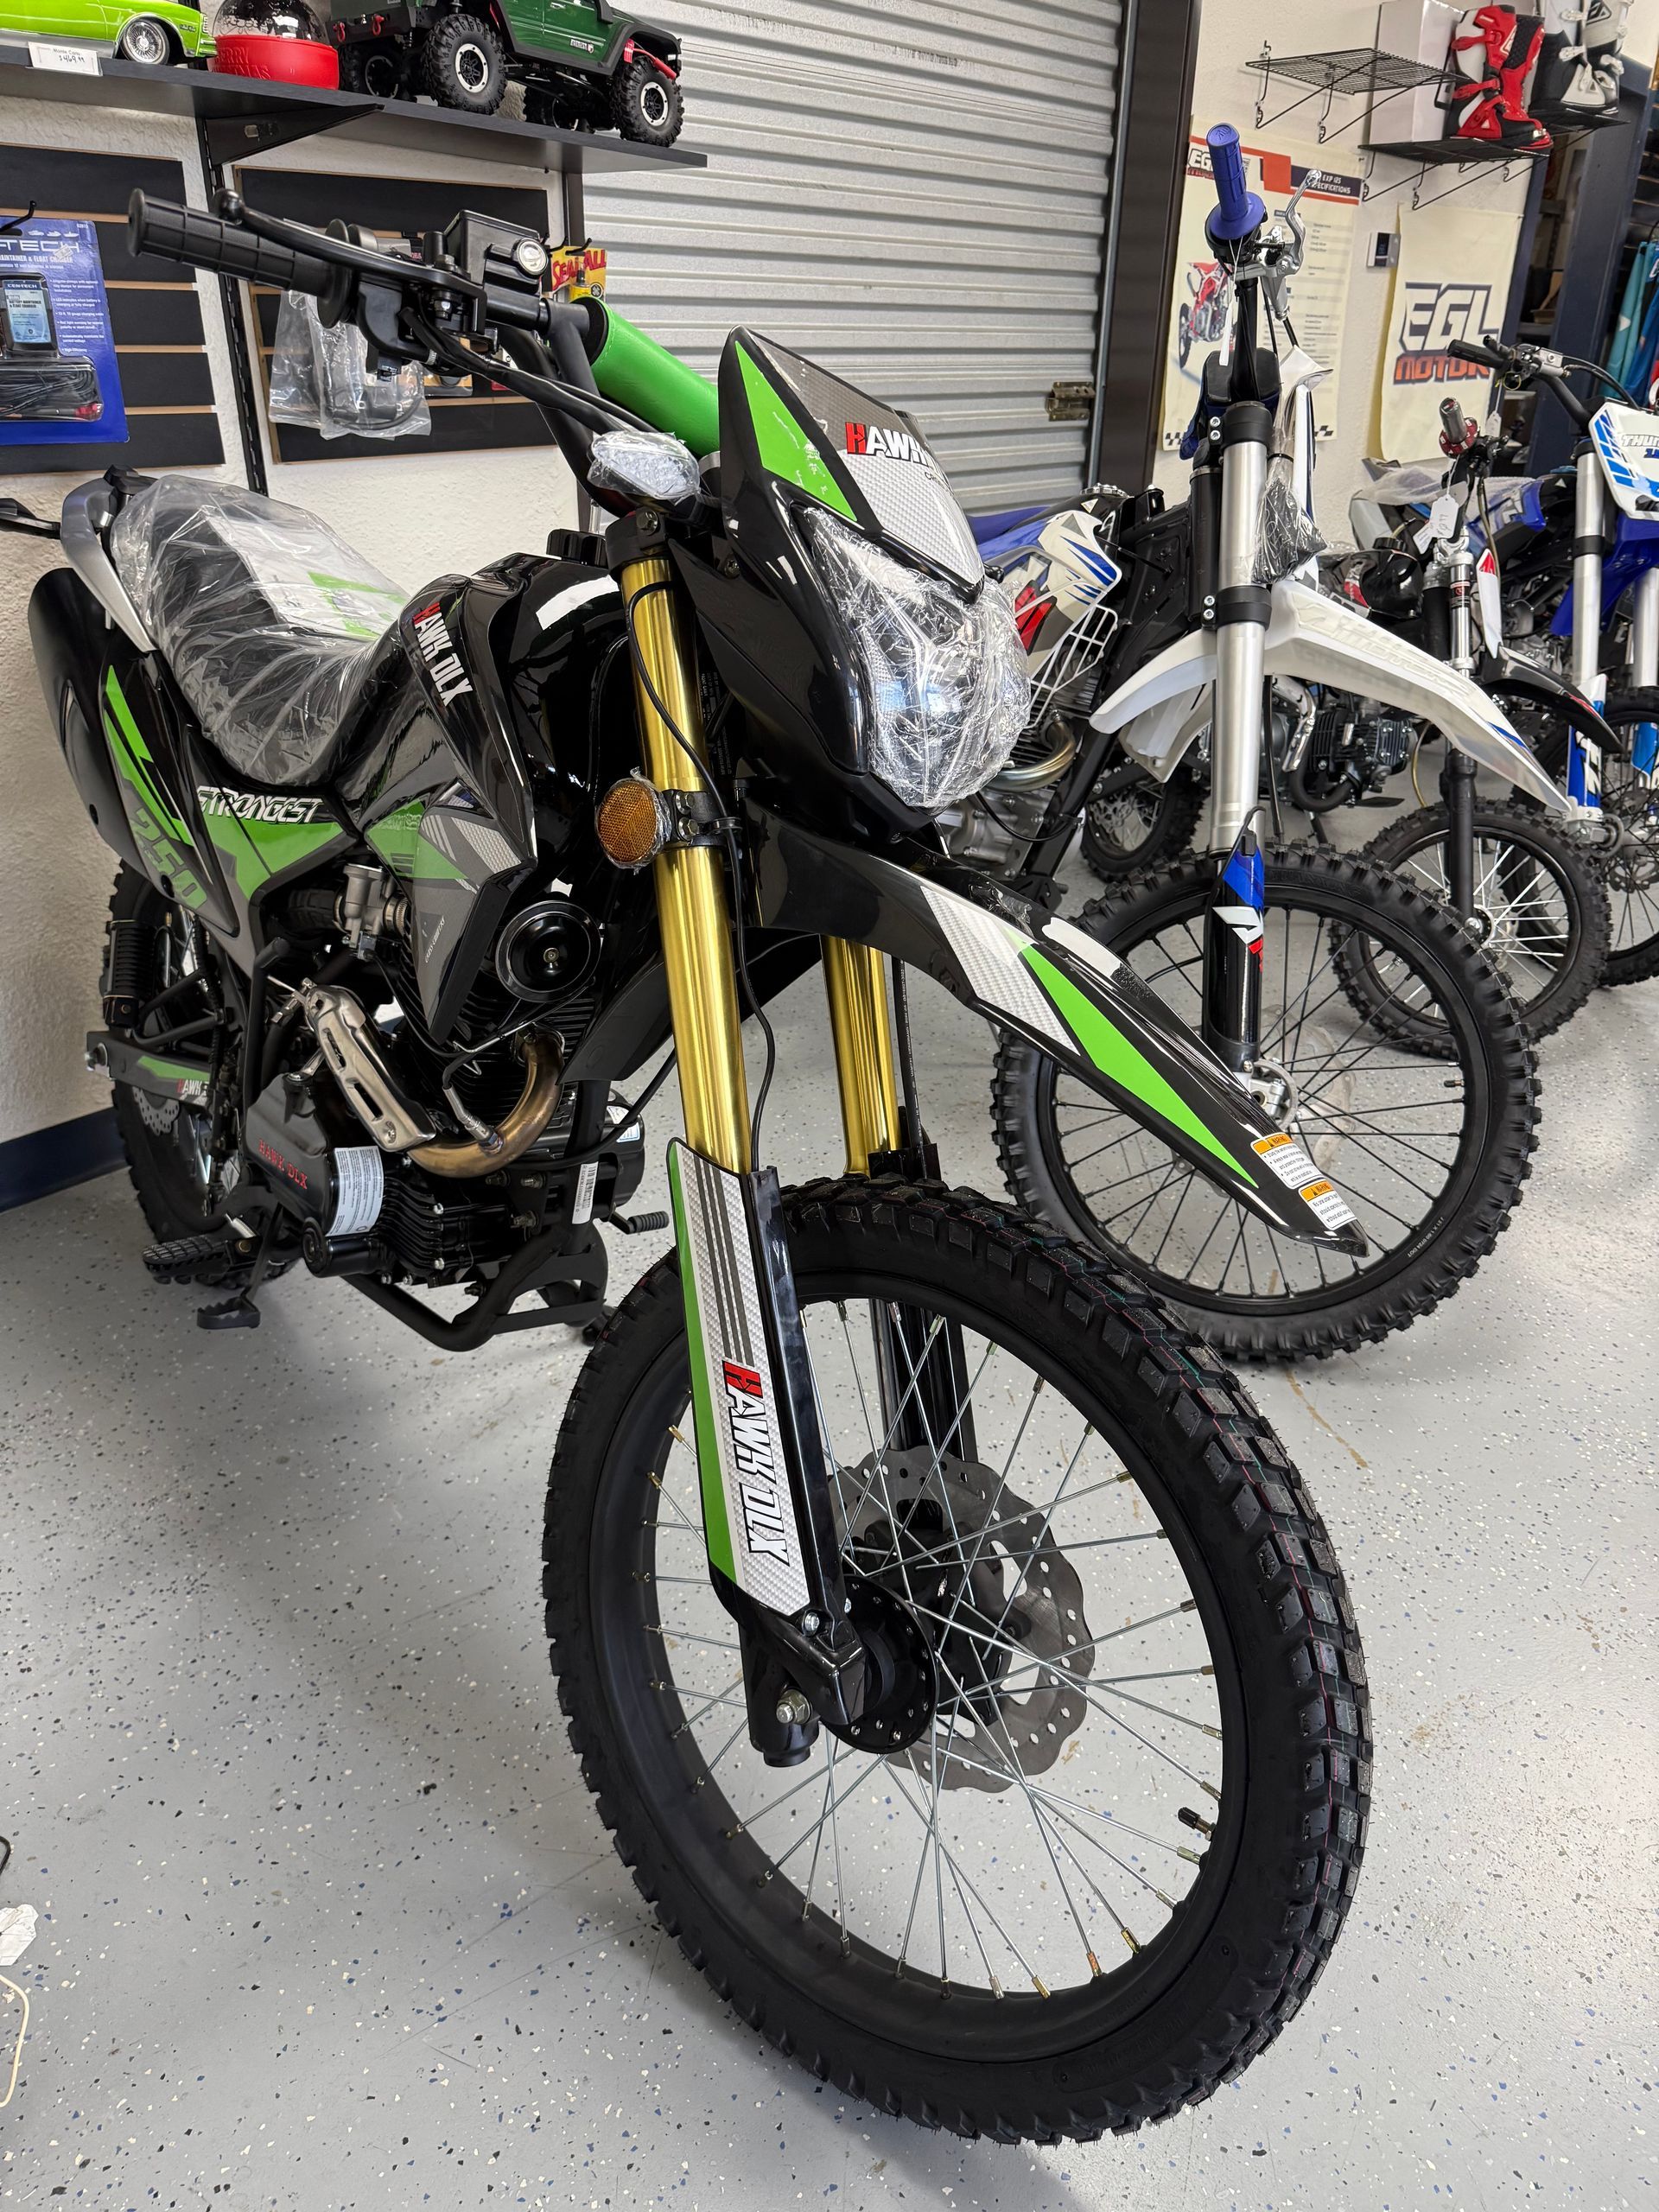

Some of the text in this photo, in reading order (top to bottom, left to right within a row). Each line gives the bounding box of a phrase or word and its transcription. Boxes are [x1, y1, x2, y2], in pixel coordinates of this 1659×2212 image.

[1398, 282, 1500, 353] EGL
[845, 422, 931, 467] HAWK
[412, 601, 474, 707] HAWK DLX
[195, 785, 325, 824] STRONGEST
[130, 807, 207, 909] 250
[176, 1078, 202, 1095] HAWK
[258, 1139, 308, 1190] HAWK DLX
[721, 1359, 790, 1567] HAWK DLX
